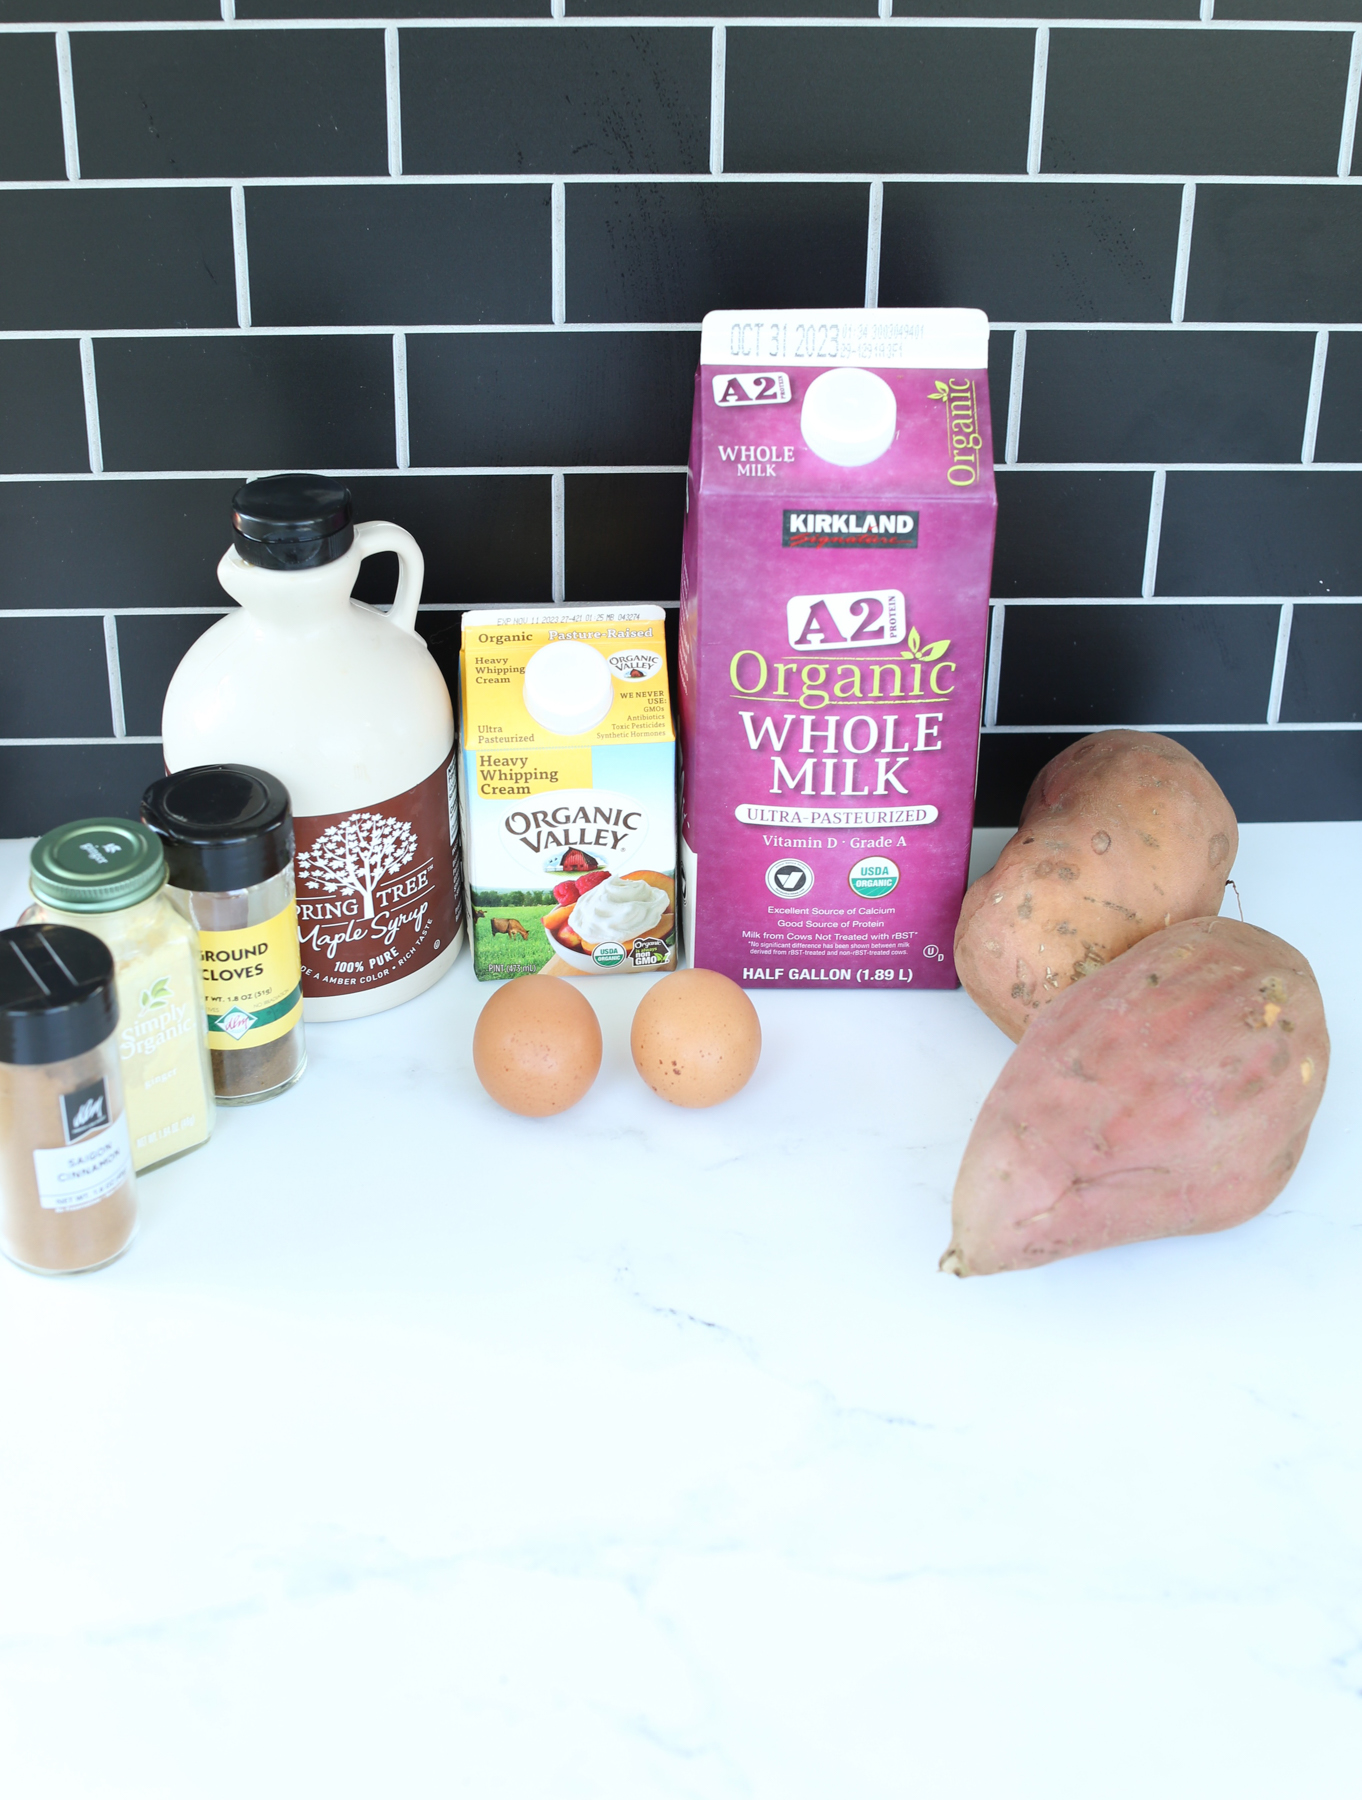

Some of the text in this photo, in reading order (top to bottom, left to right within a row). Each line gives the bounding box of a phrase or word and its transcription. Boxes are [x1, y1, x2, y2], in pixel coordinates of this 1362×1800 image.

[730, 323, 840, 359] OCT 31 2023
[718, 376, 778, 403] A2
[947, 378, 983, 488] Organic
[717, 446, 795, 463] WHOLE
[737, 464, 777, 478] MILK
[790, 514, 914, 534] KIRKLAND
[789, 533, 914, 550] Signature
[542, 615, 559, 625] 2023
[794, 598, 886, 646] A2
[888, 595, 898, 638] PROTEIN
[478, 628, 653, 645] Organic Pasture-Raised
[475, 656, 509, 666] Heavy
[609, 654, 659, 666] ORGANIC
[615, 662, 654, 672] VALLEY
[475, 665, 526, 676] Whipping
[475, 676, 511, 684] Cream
[729, 650, 957, 710] Organic
[638, 690, 664, 698] NEVER
[647, 697, 667, 705] USE:
[643, 705, 665, 713] GMOs
[627, 713, 665, 721] Antibiotics
[478, 725, 503, 734] Ultra
[611, 721, 665, 731] Toxic Pesticides
[738, 711, 944, 755] WHOLE
[478, 734, 535, 744] Pasteurized
[596, 730, 666, 740] Synthetic Hormones
[480, 755, 528, 768] Heavy
[480, 769, 559, 784] Whipping
[769, 756, 910, 796] MILK
[480, 784, 531, 795] Cream
[505, 806, 642, 836] ORGANIC
[747, 807, 928, 825] ULTRA-PASTEURIZED
[763, 835, 907, 849] Vitamin D Grade A
[860, 866, 889, 876] USDA
[856, 878, 893, 888] ORGANIC
[296, 898, 359, 921] RING
[767, 906, 896, 916] Excellent Source of Calcium
[371, 902, 429, 946] Syrup
[777, 919, 885, 928] Good Source of Protein
[742, 930, 761, 939] Milk
[763, 931, 784, 940] from
[786, 932, 813, 941] Cows
[815, 933, 832, 941] Not
[834, 933, 868, 941] Treated
[870, 932, 890, 940] with
[322, 975, 357, 985] AMBER
[359, 968, 390, 984] COLOR
[397, 946, 417, 967] RICH
[415, 918, 433, 946] TASTE
[760, 941, 791, 949] significant
[791, 941, 822, 949] difference
[334, 961, 365, 973] 100%
[368, 946, 400, 970] PURE
[635, 956, 657, 965] GMO
[742, 968, 914, 983] HALF GALLON (1.89 L)
[121, 1003, 187, 1042] Simply
[119, 1018, 192, 1060] Organic
[68, 1142, 112, 1167] SAIGON
[57, 1149, 120, 1182] CINNAMON
